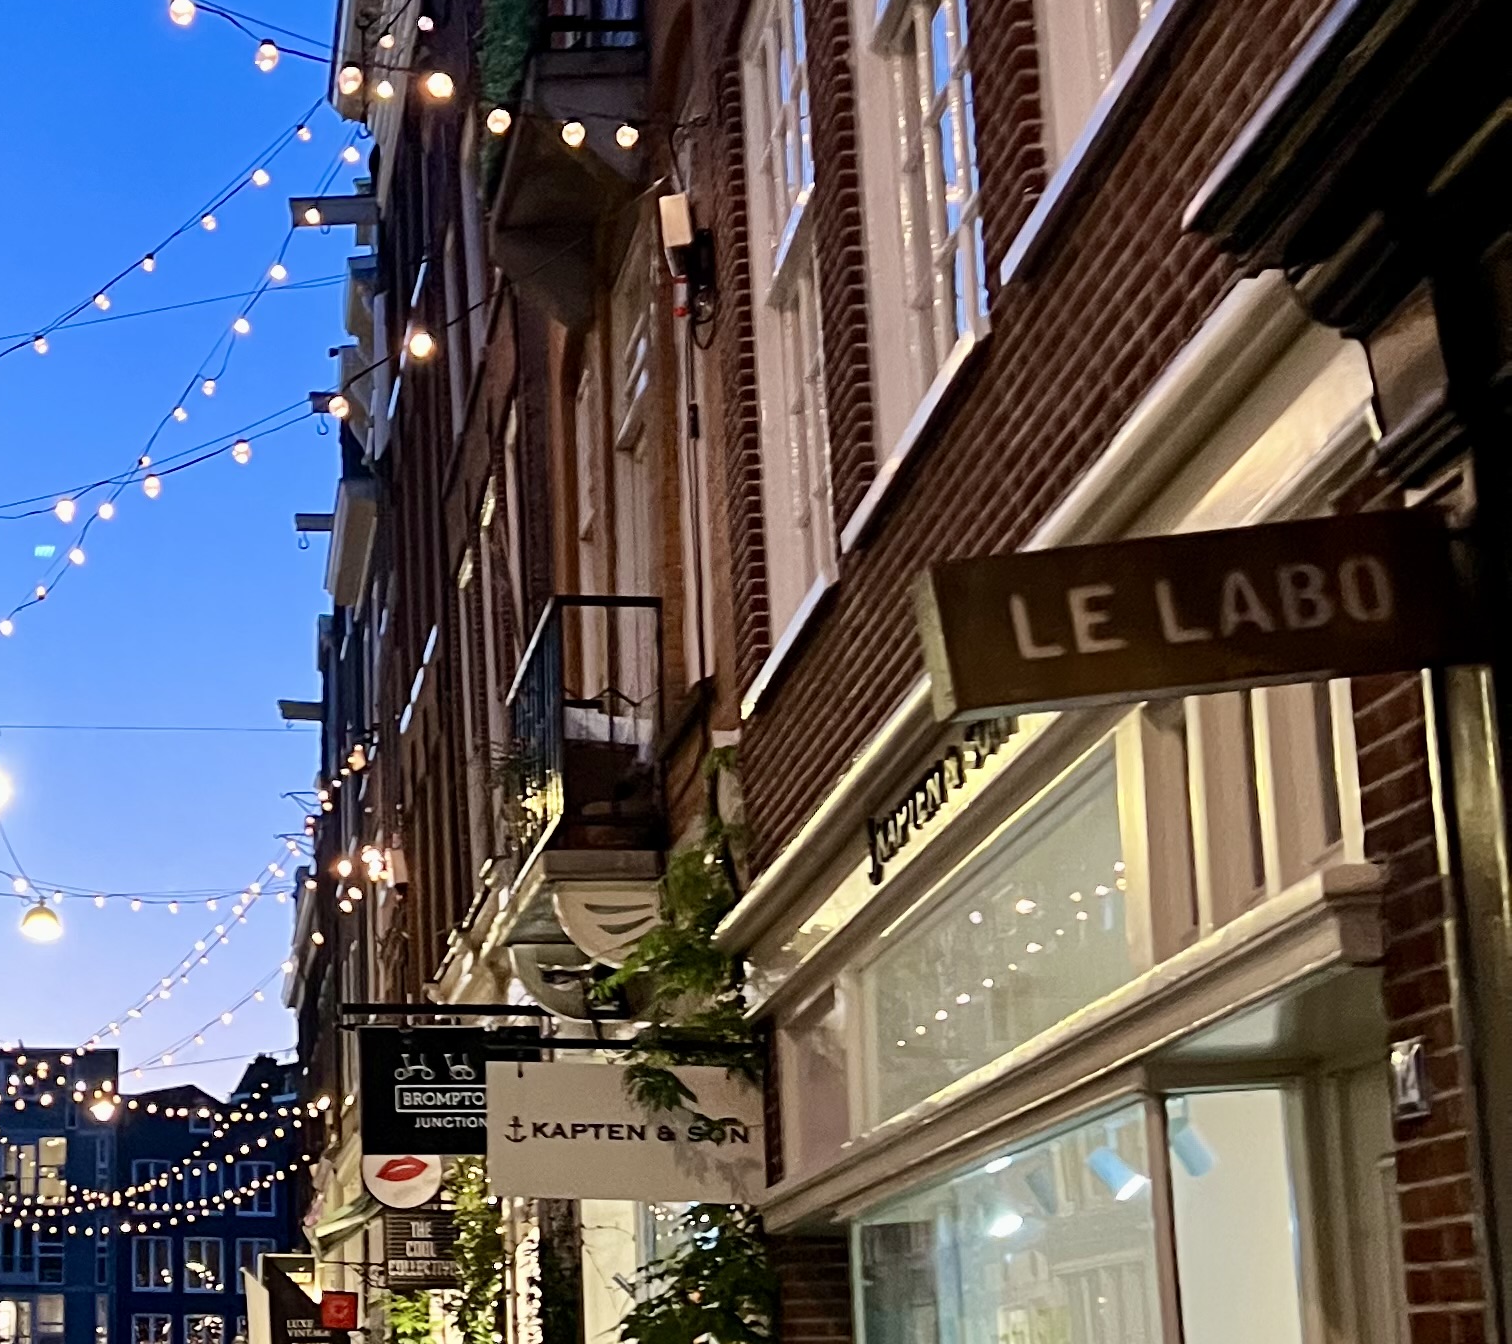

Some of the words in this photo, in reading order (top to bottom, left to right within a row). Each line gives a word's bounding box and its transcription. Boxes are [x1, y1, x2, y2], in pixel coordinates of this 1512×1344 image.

[1009, 583, 1128, 660] LE
[1155, 555, 1393, 644] LABO
[402, 1091, 486, 1106] BROMPTO
[531, 1122, 646, 1141] KAPTEN
[656, 1124, 676, 1141] &
[687, 1123, 749, 1144] SON
[405, 1241, 437, 1258] COOL
